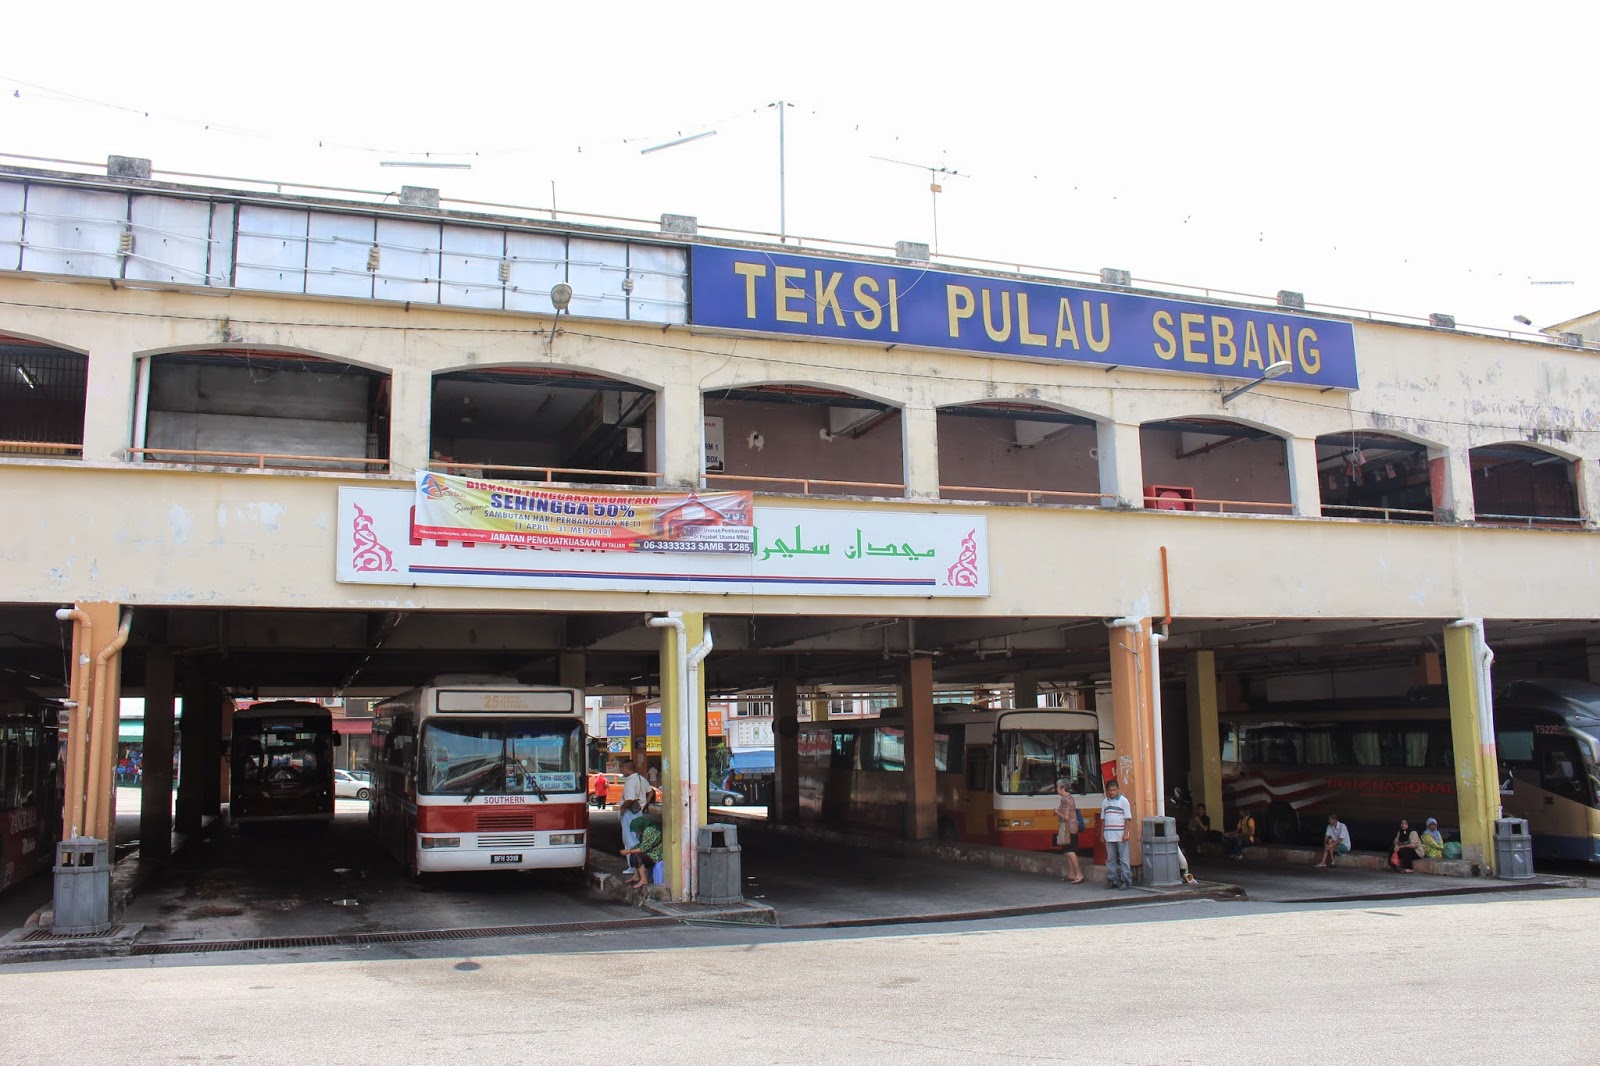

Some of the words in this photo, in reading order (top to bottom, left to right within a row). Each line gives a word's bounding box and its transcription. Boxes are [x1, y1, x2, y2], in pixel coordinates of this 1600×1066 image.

[734, 262, 899, 332] TEKSI
[946, 284, 1111, 352] PULAU
[1152, 310, 1321, 375] SEBANG
[706, 455, 718, 463] BOX
[491, 493, 589, 516] SEHINGGA
[594, 503, 635, 518] 50%
[484, 510, 530, 521] SAMBUTAN
[533, 515, 553, 523] HARI
[556, 516, 617, 527] PERBANDARAN
[619, 520, 641, 528] KE-11
[526, 523, 550, 531] APRIL
[558, 525, 567, 533] 31
[570, 526, 585, 535] MEI
[588, 528, 611, 537] 2014)
[490, 533, 525, 543] JABATAN
[527, 535, 600, 547] PENGUATKUASAAN
[643, 541, 696, 550] 06-3333333
[698, 542, 727, 551] SAMB.
[728, 543, 750, 551] 1285
[484, 695, 499, 709] 25
[1325, 777, 1456, 795] TRANSNASIONAL
[484, 796, 525, 804] SOUTHERN
